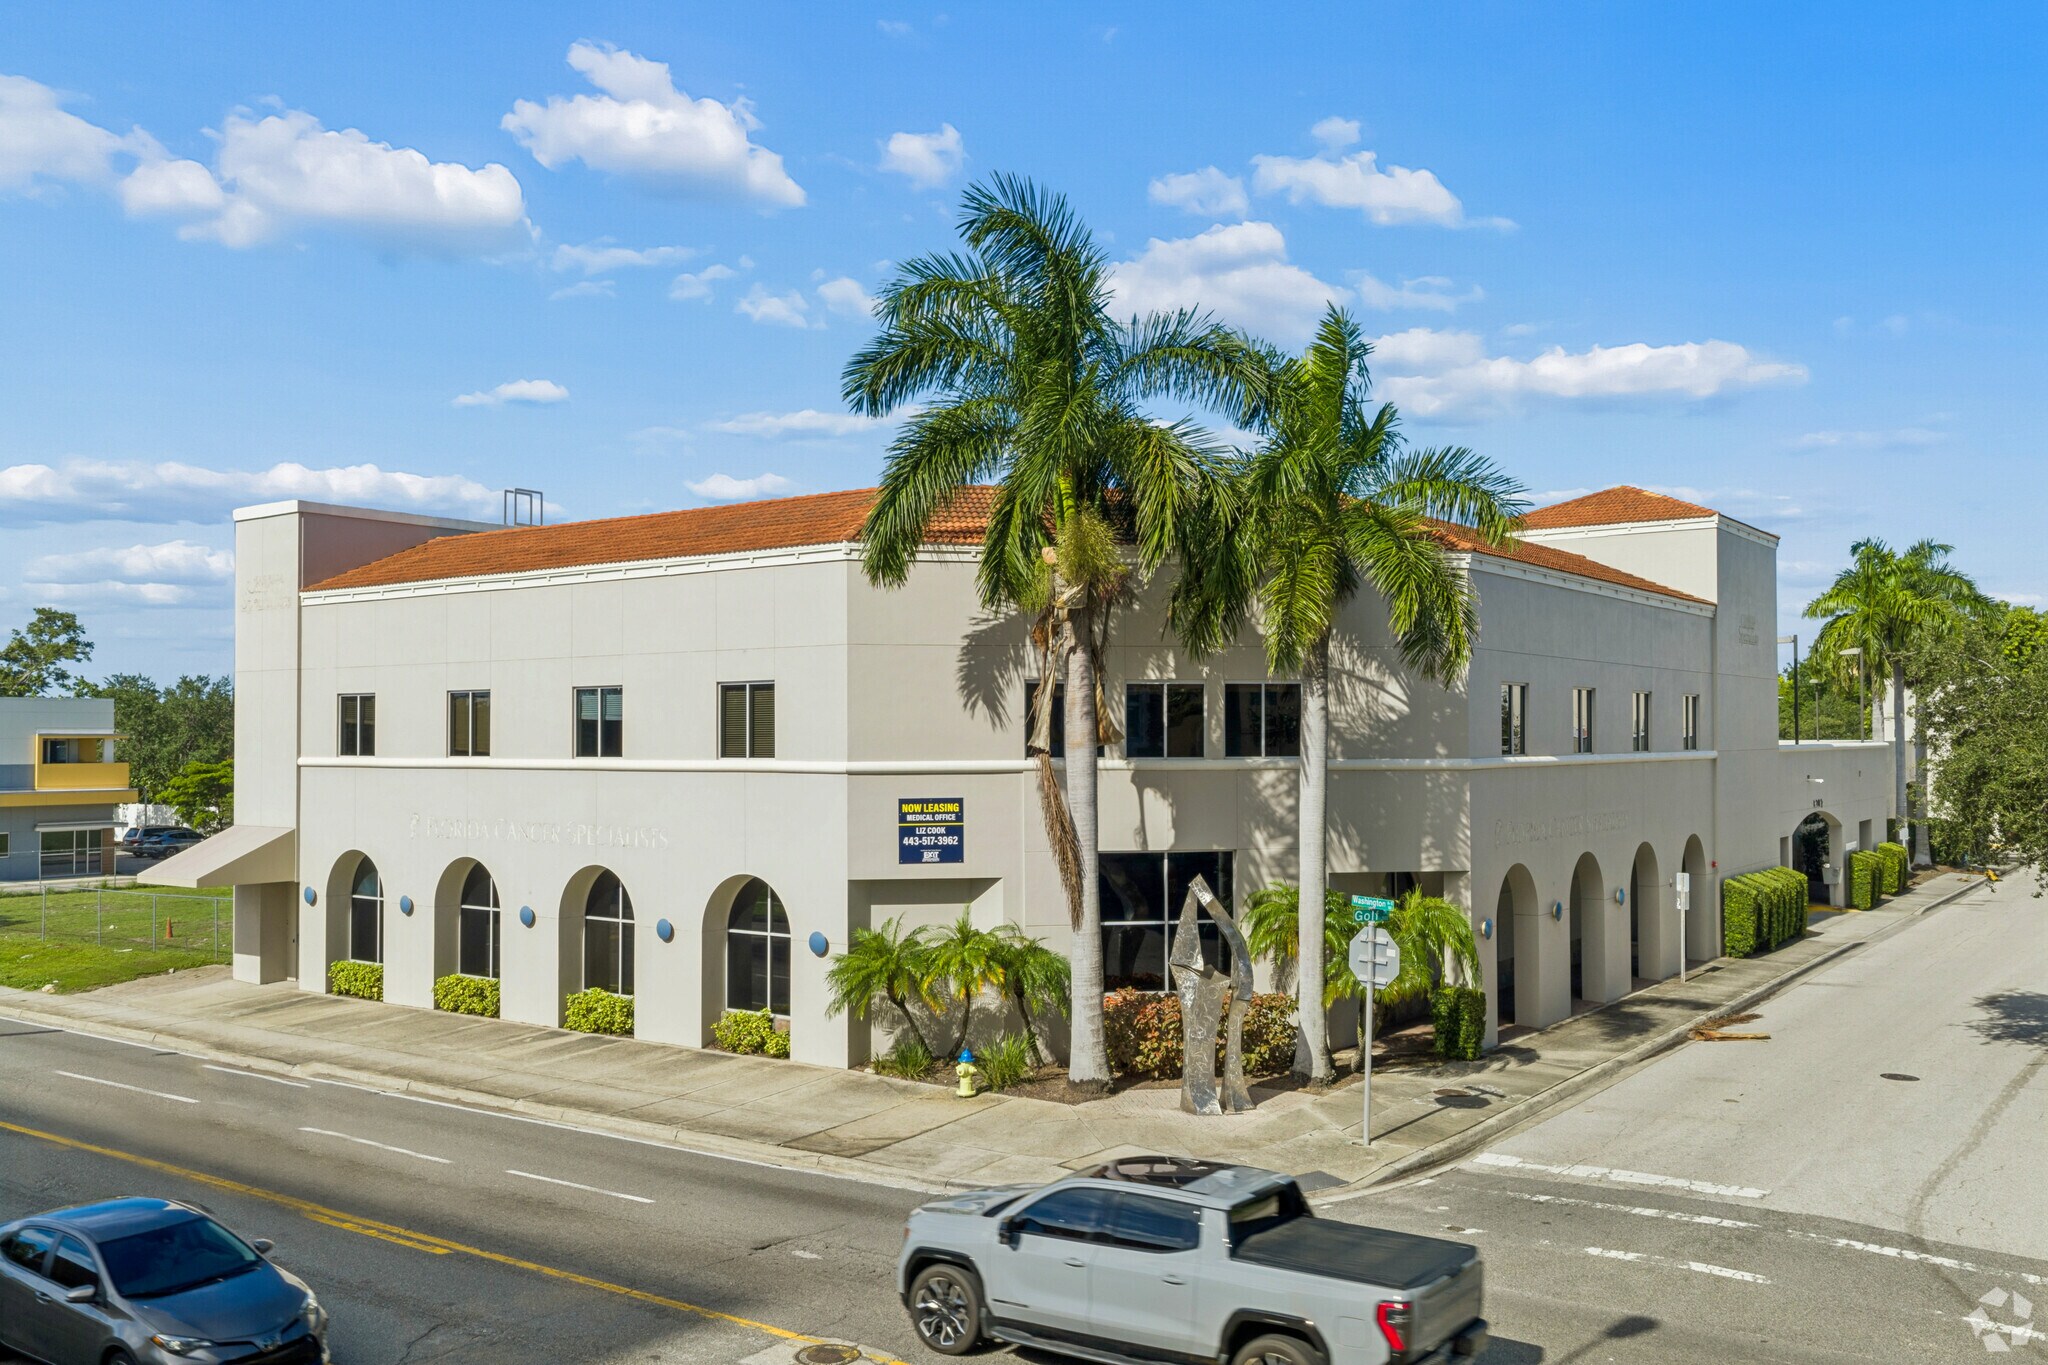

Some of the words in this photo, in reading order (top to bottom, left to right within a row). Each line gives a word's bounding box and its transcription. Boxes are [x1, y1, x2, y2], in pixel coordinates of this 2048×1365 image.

[902, 804, 922, 813] NOW
[924, 803, 959, 812] LEASING
[934, 813, 956, 821] OFFICE
[916, 827, 926, 835] LIZ
[903, 836, 958, 845] 443-517-3962
[1353, 896, 1386, 908] Washington
